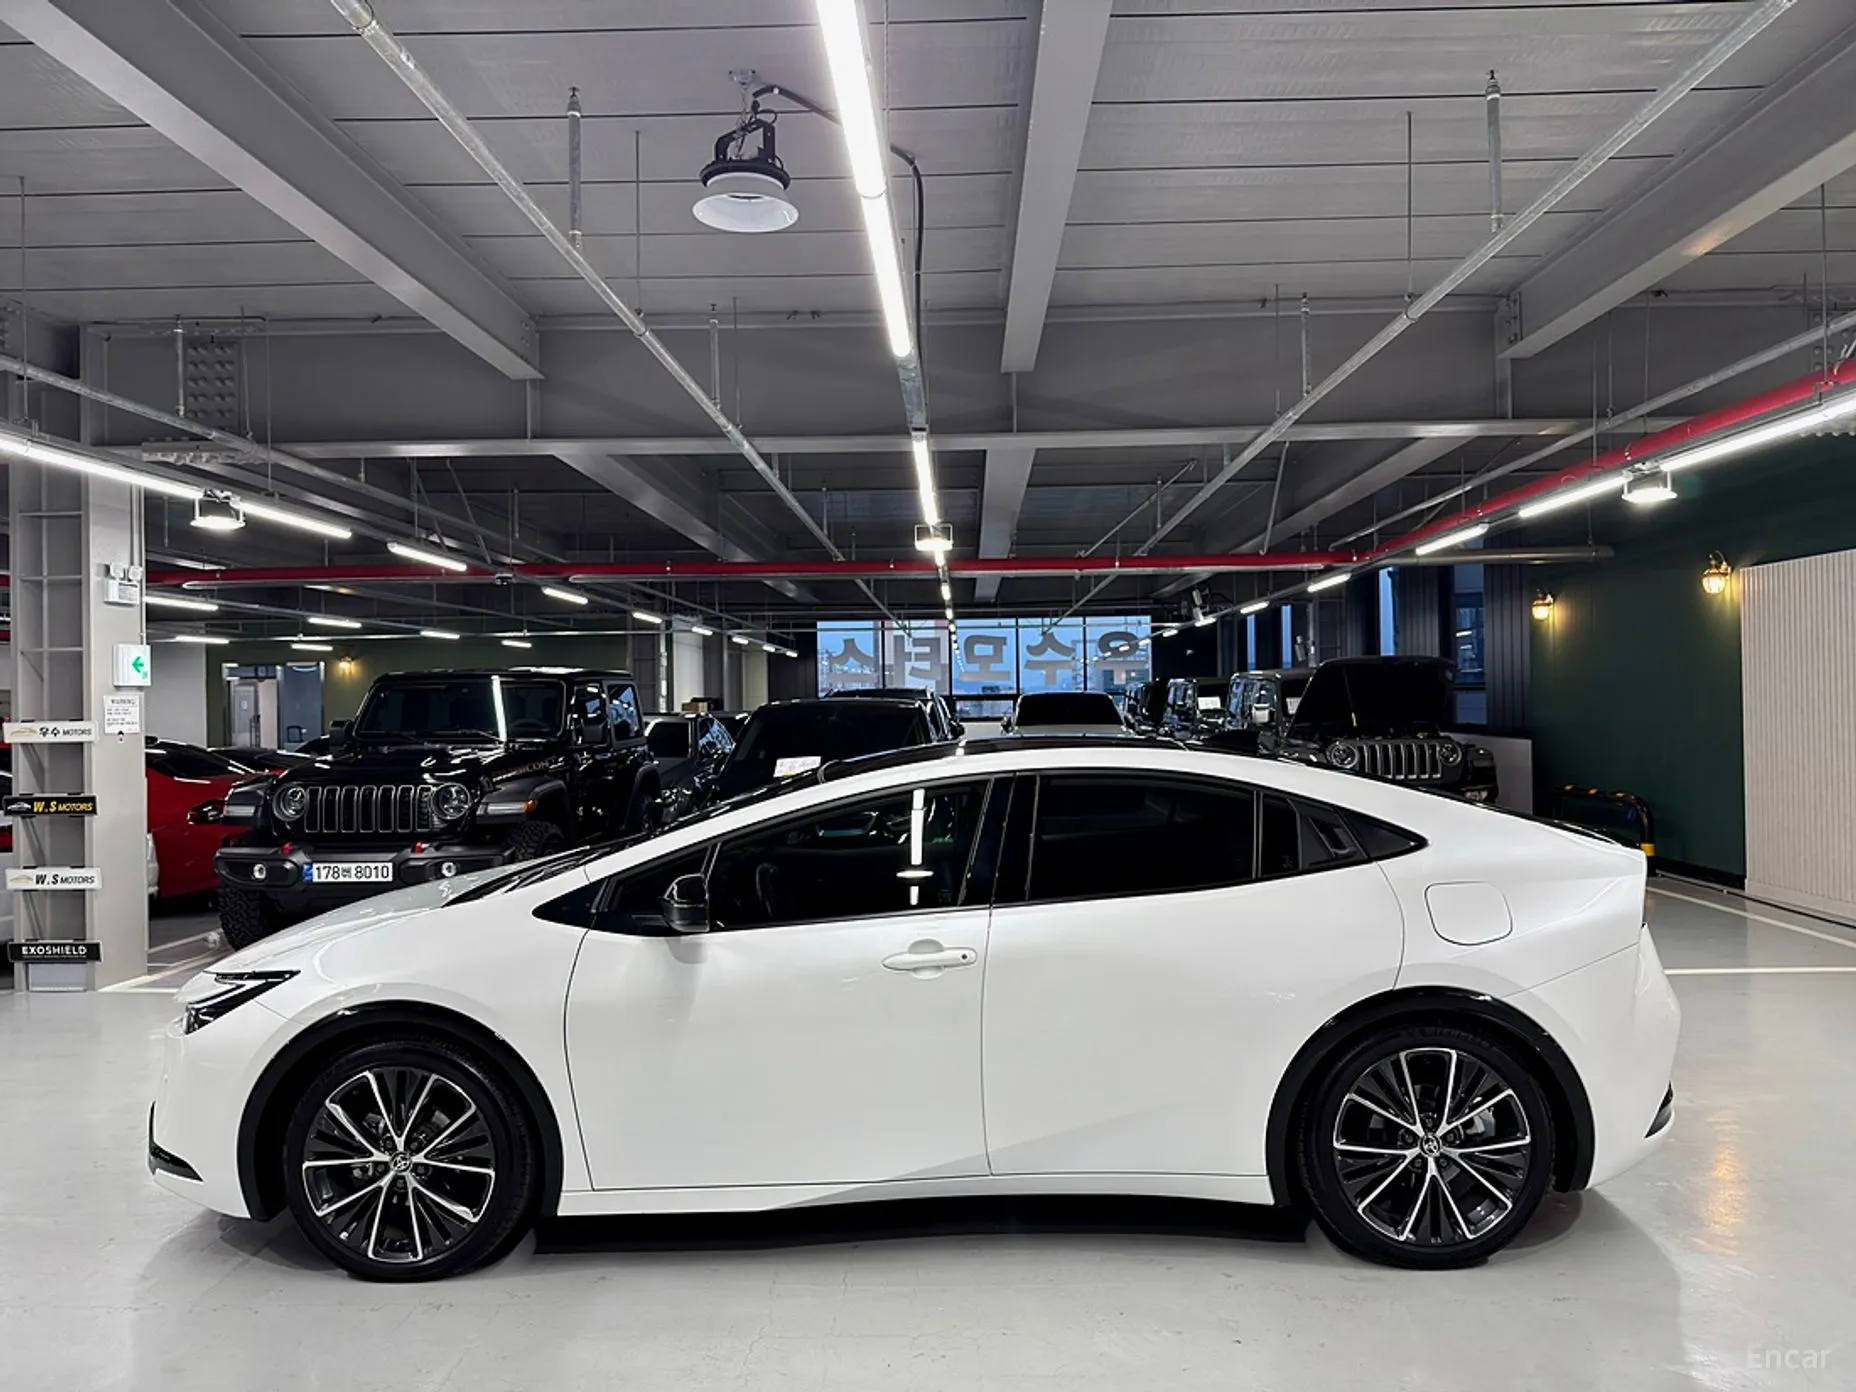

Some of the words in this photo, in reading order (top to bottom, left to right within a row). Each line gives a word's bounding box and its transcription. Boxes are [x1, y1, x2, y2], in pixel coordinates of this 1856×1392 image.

[62, 728, 92, 736] MOTORS
[58, 803, 93, 811] MOTORS
[354, 865, 389, 879] 8010
[60, 876, 95, 884] MOTORS
[21, 945, 87, 955] EXOSHIELD
